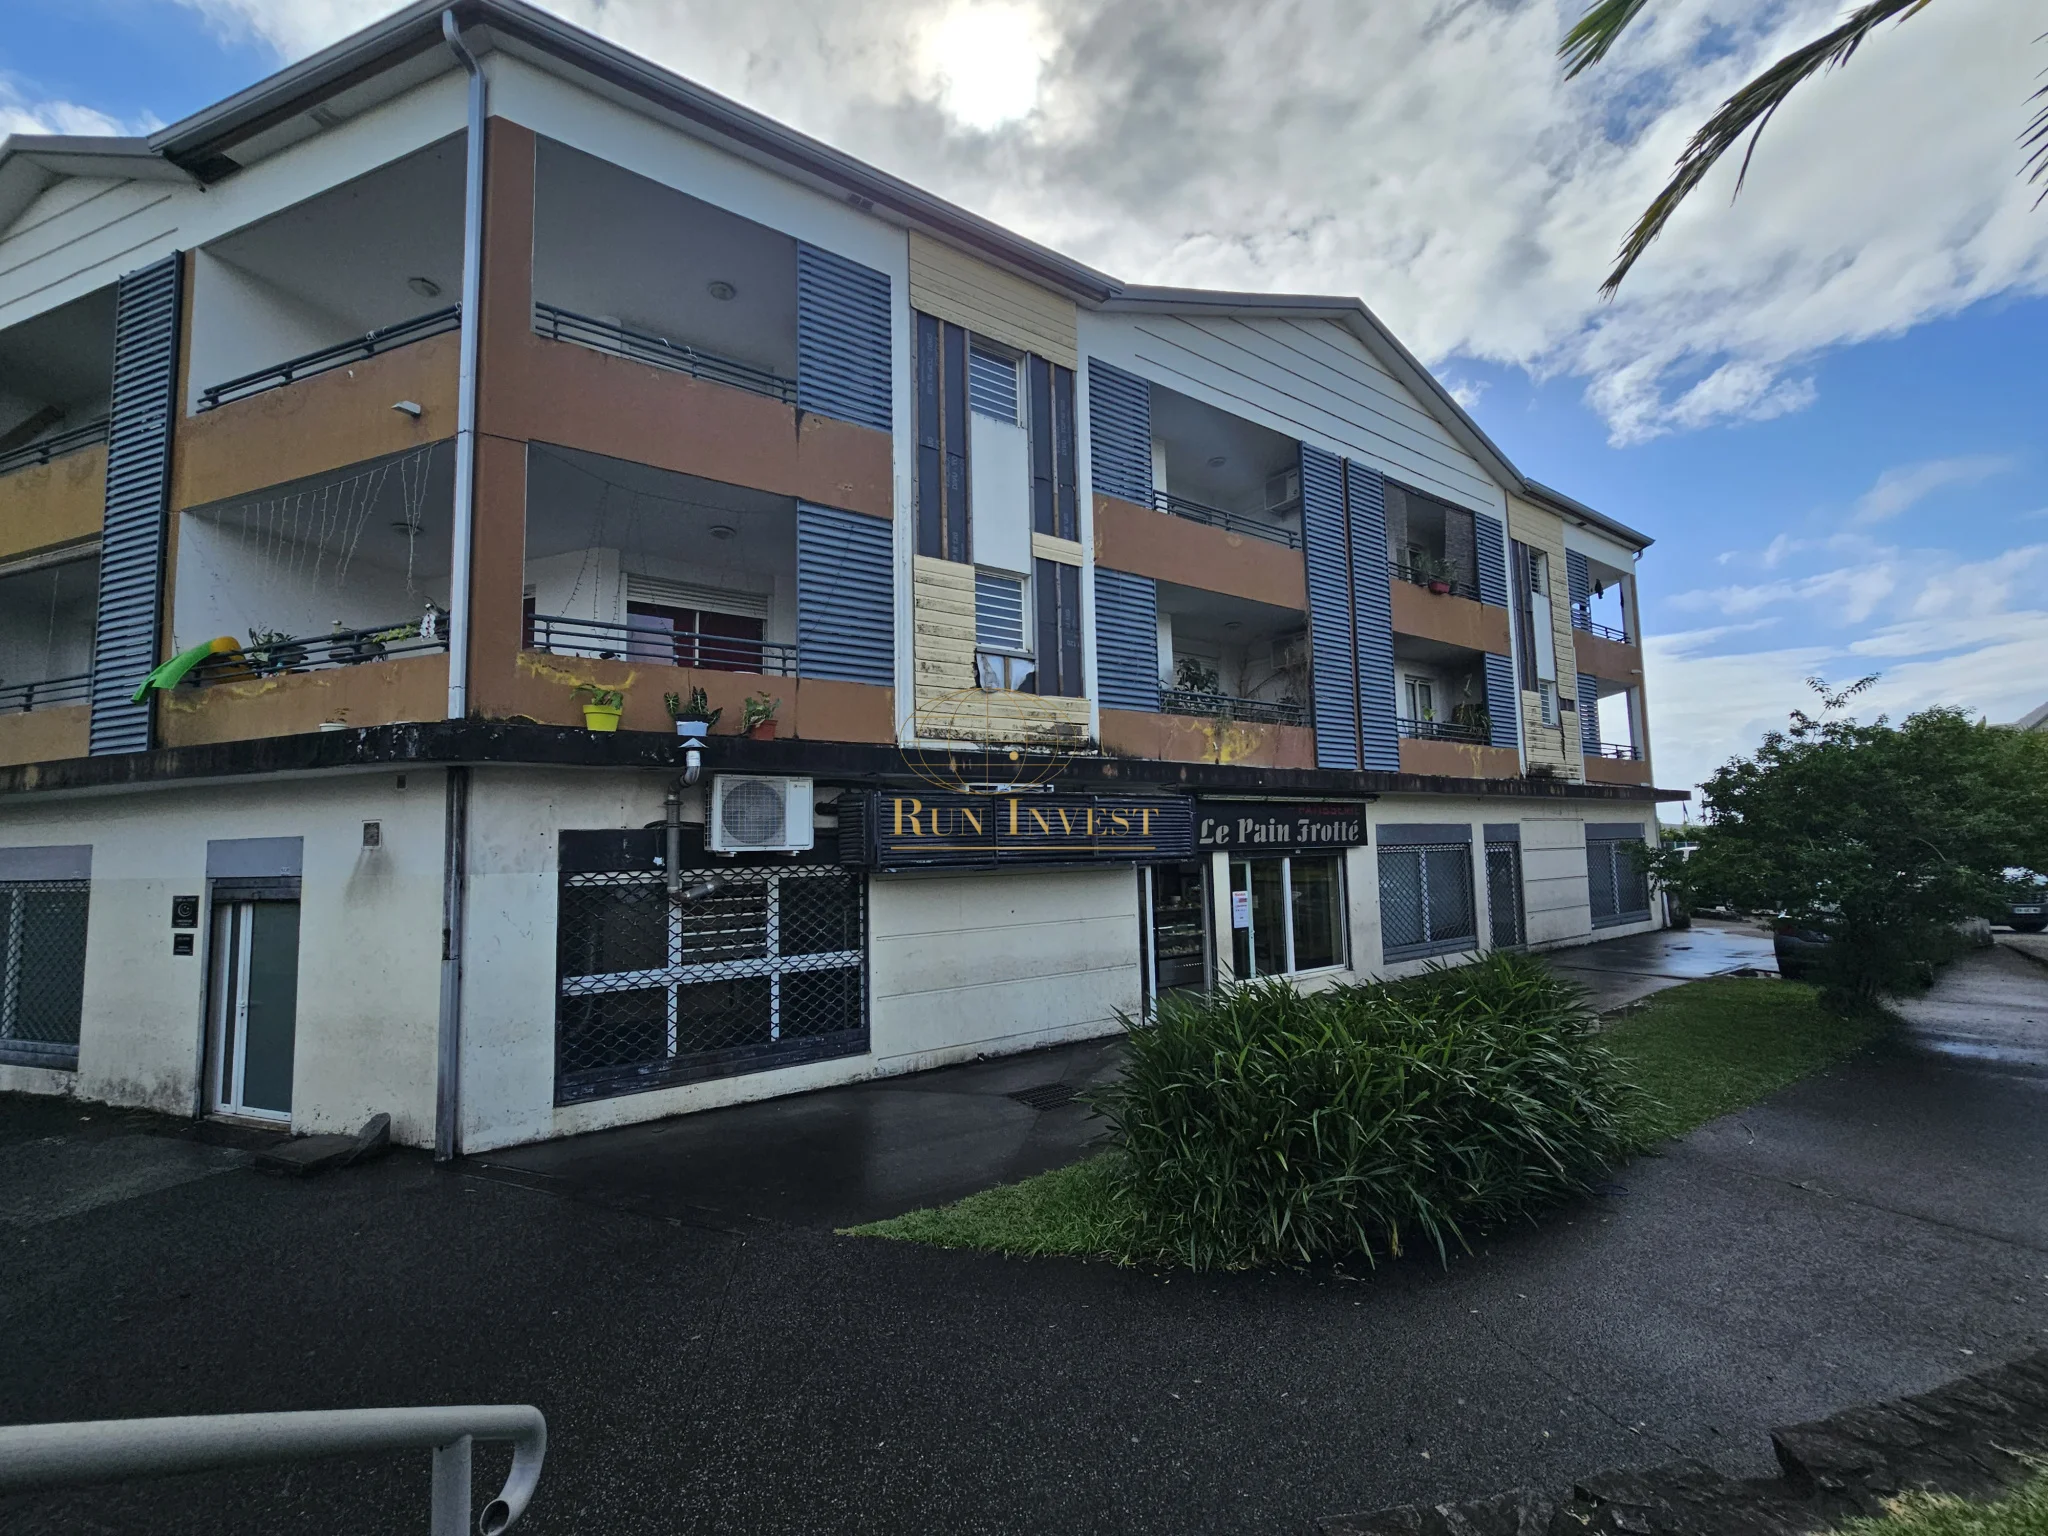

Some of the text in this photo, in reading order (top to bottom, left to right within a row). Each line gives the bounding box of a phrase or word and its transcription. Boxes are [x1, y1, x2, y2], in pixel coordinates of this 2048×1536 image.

[1199, 817, 1359, 844] Le Pain Frotté
